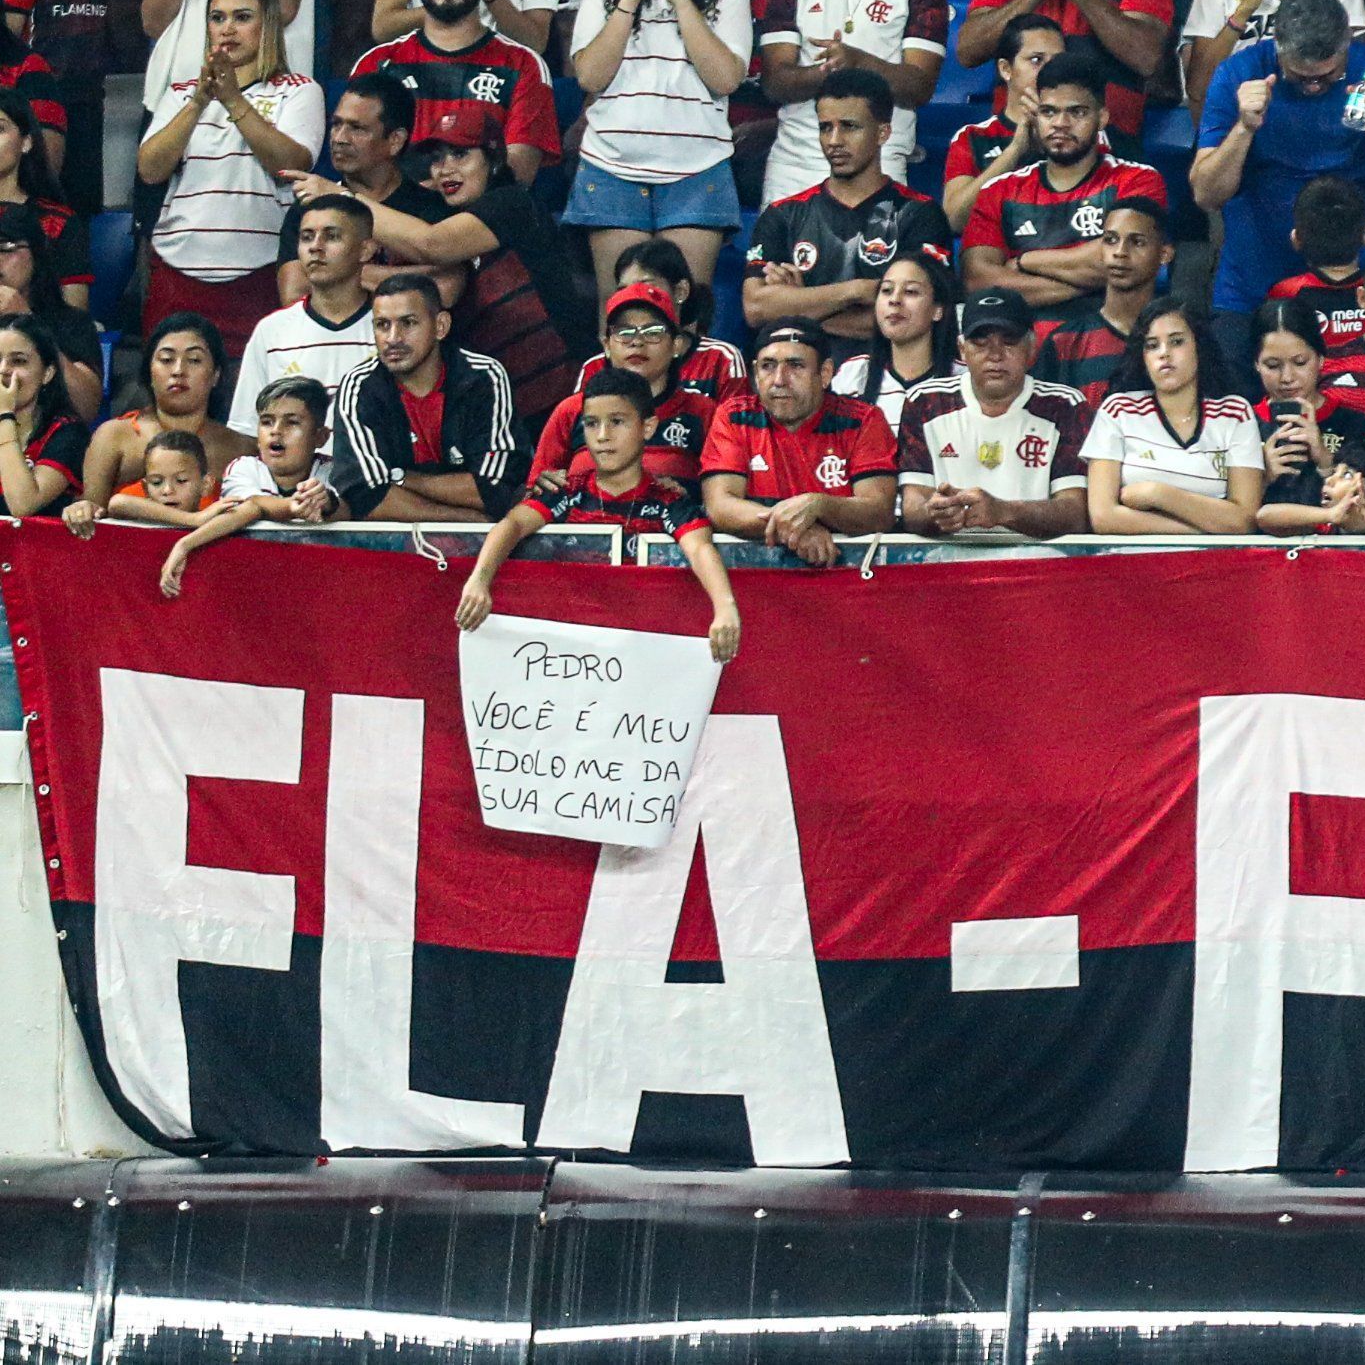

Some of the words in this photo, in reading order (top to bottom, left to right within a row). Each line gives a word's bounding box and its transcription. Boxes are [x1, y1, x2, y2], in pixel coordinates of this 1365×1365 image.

[1331, 320, 1363, 334] livre
[513, 641, 623, 682] PEDRO
[472, 691, 556, 731] VOCÊ
[576, 701, 597, 731] É
[613, 713, 690, 743] MEU
[475, 739, 566, 778] ÍDOLO
[575, 760, 623, 782] ME
[643, 760, 681, 782] DA
[482, 784, 538, 815] SUA
[94, 666, 851, 1167] FLA
